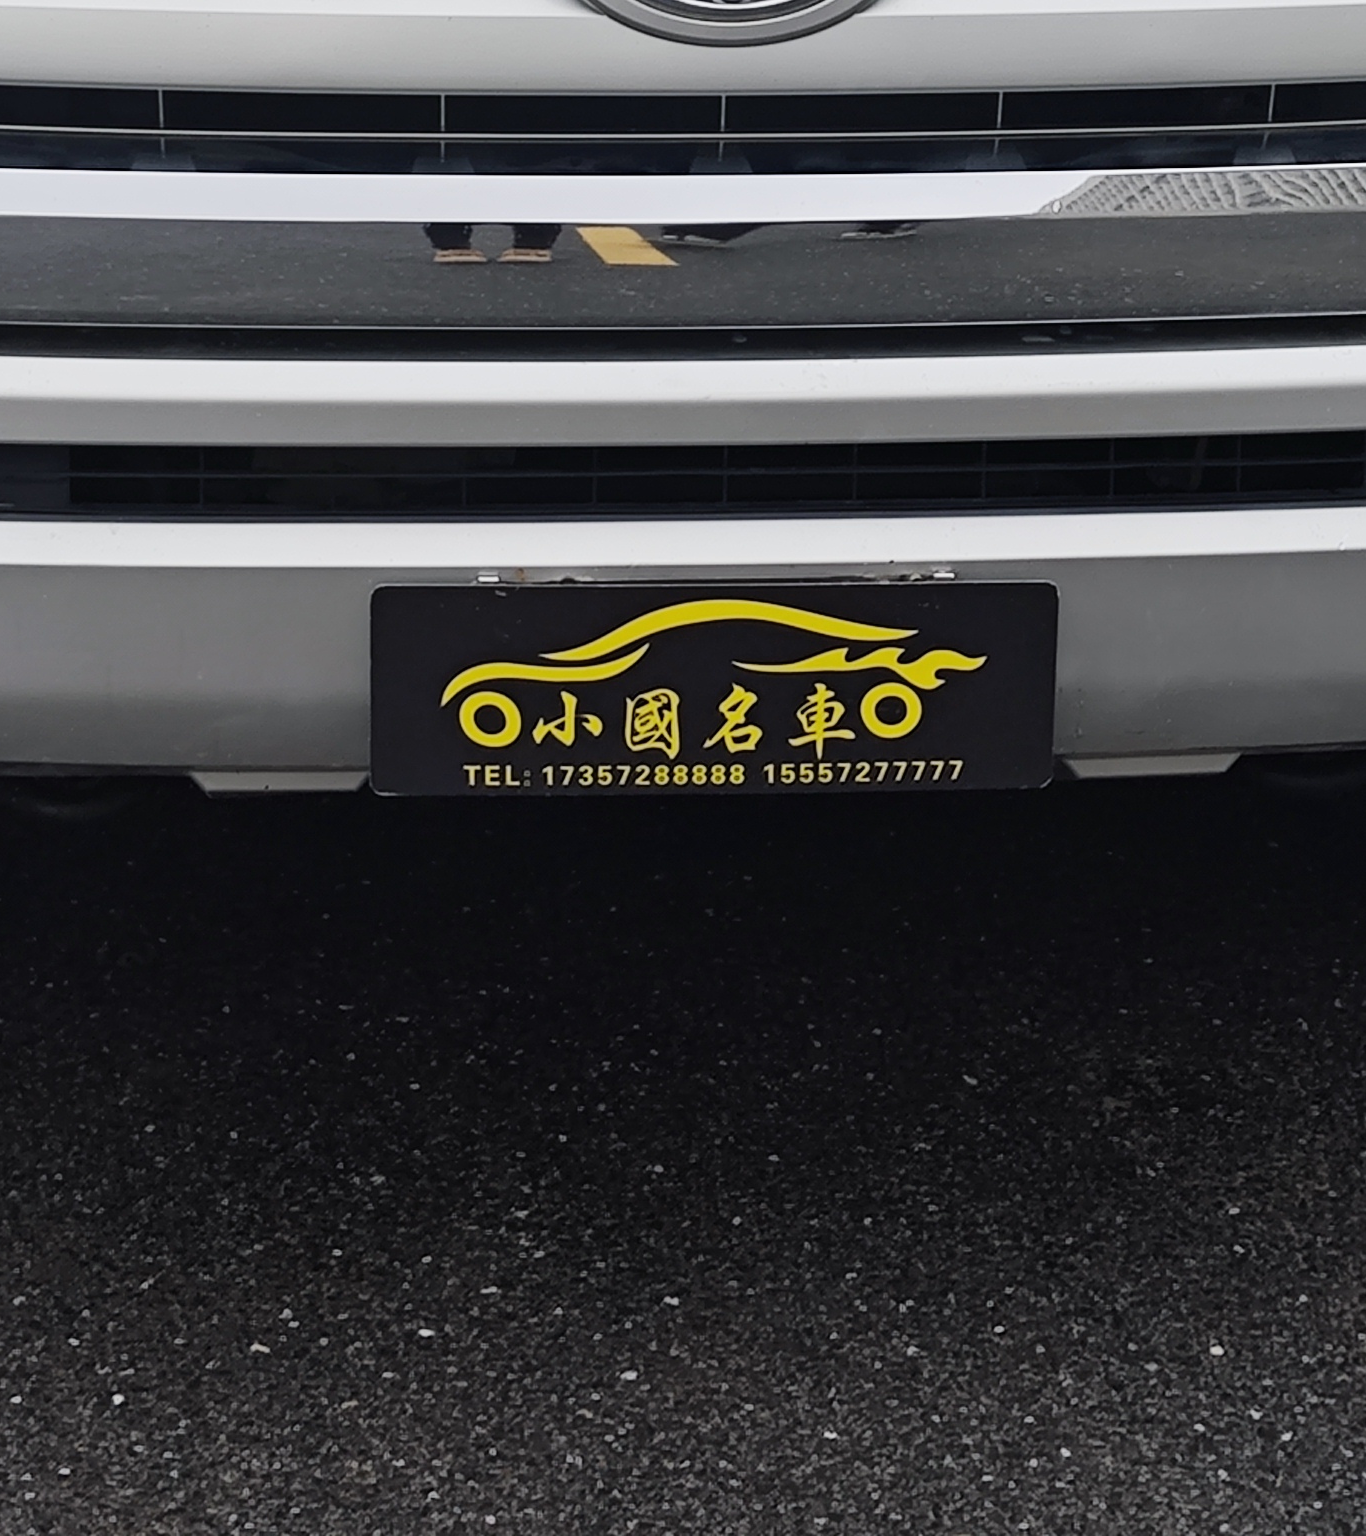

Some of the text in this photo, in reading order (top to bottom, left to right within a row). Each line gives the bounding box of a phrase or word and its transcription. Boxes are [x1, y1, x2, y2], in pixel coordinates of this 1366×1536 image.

[532, 682, 857, 760] 小國名車
[463, 759, 964, 788] TEL: 17357288888 15557277777
